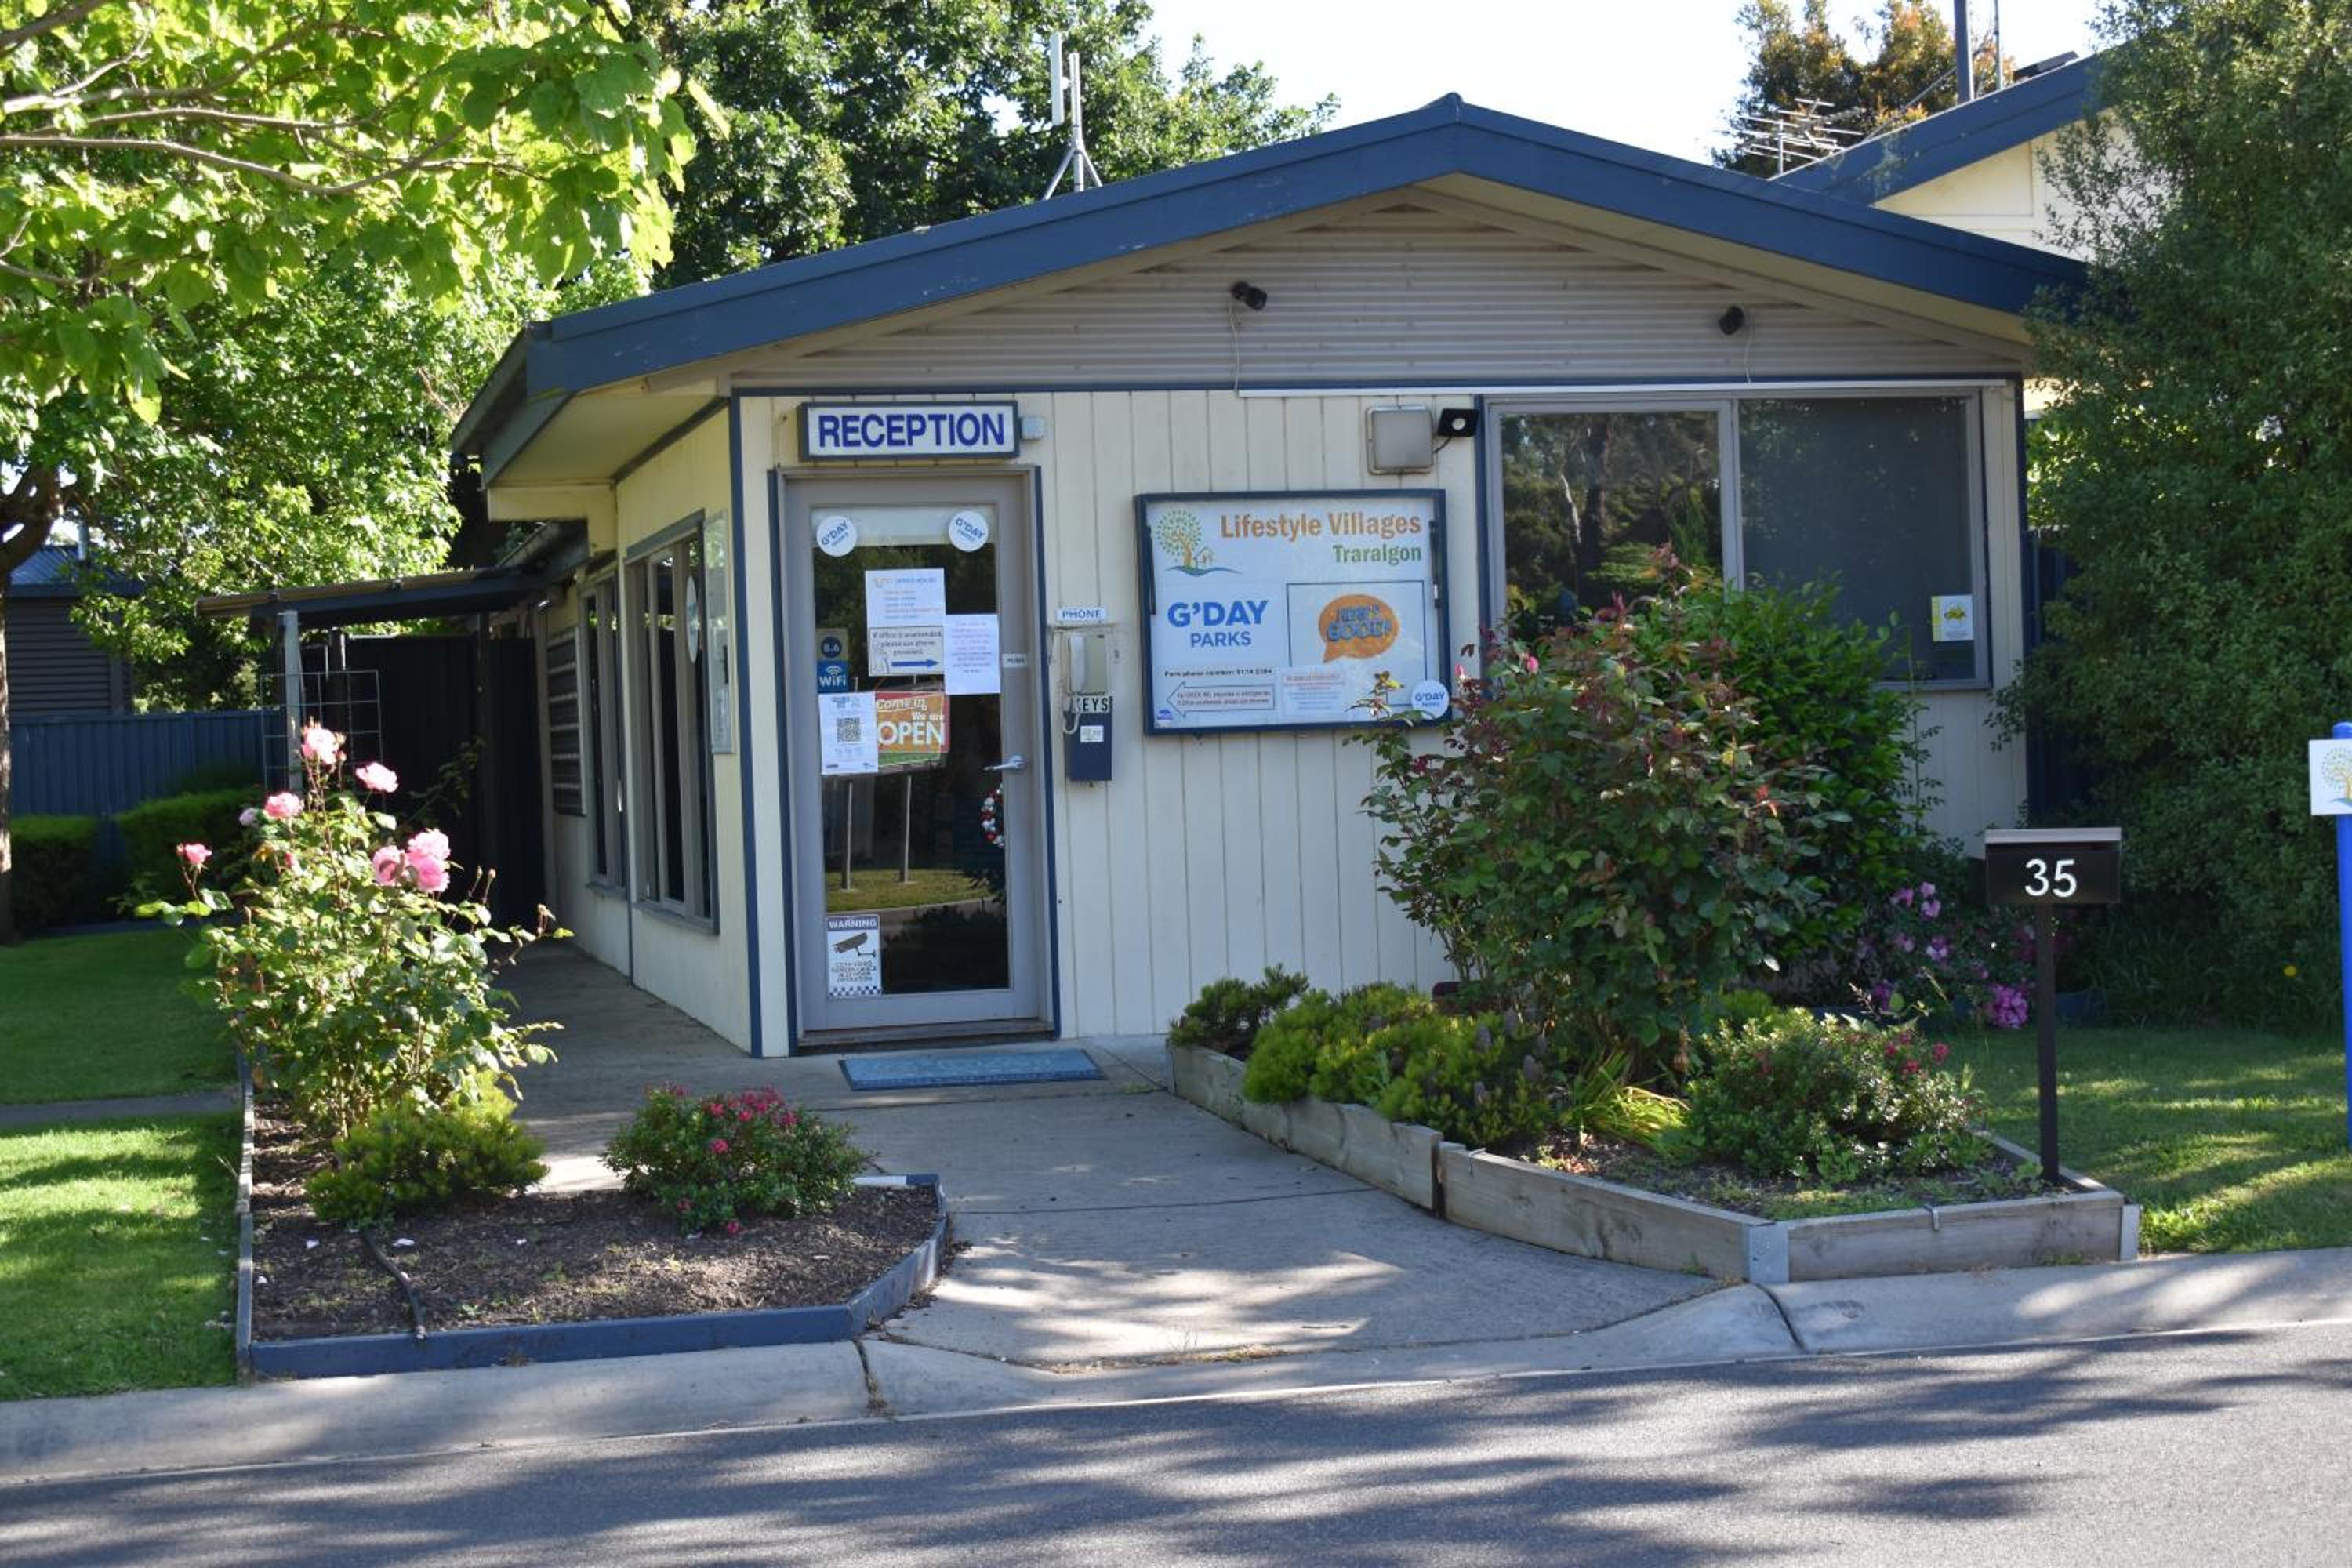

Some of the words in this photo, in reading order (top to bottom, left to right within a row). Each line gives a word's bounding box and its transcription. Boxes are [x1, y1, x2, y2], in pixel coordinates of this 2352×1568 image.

[818, 413, 1004, 448] RECEPTION
[1221, 514, 1322, 542] Lifestyle
[1327, 512, 1421, 539] Villages
[1333, 544, 1421, 565] Traralgon
[1062, 609, 1102, 619] PHONE
[1167, 600, 1269, 627] G'DAY
[1191, 631, 1252, 648] PARKS
[819, 675, 846, 687] WiFi
[1415, 691, 1445, 702] G'DAY
[877, 720, 945, 746] OPEN
[2024, 858, 2077, 898] 35
[829, 919, 877, 929] WARNING
